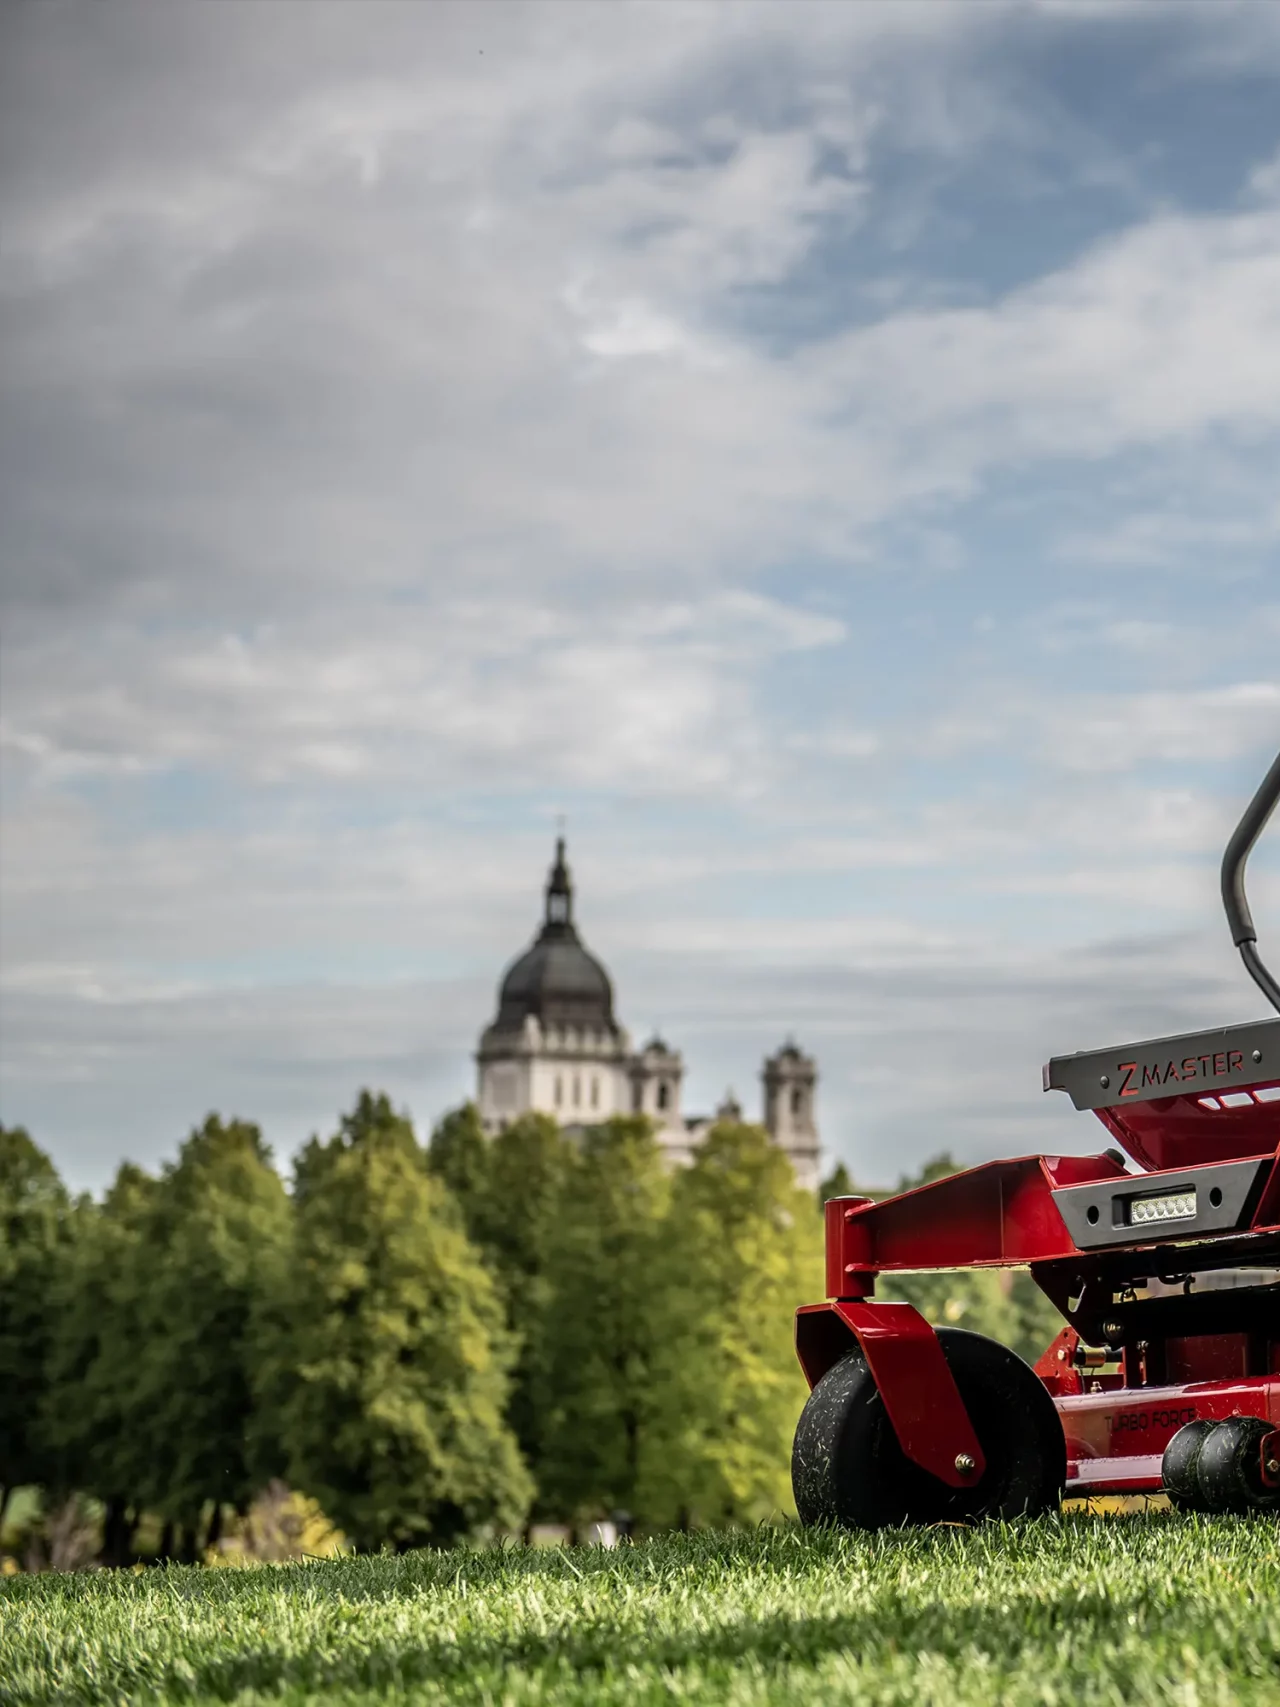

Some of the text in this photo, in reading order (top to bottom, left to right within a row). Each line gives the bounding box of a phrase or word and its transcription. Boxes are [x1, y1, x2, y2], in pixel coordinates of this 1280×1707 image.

[1117, 1050, 1244, 1097] Z MASTER
[1104, 1408, 1195, 1432] TURBO FORCE
